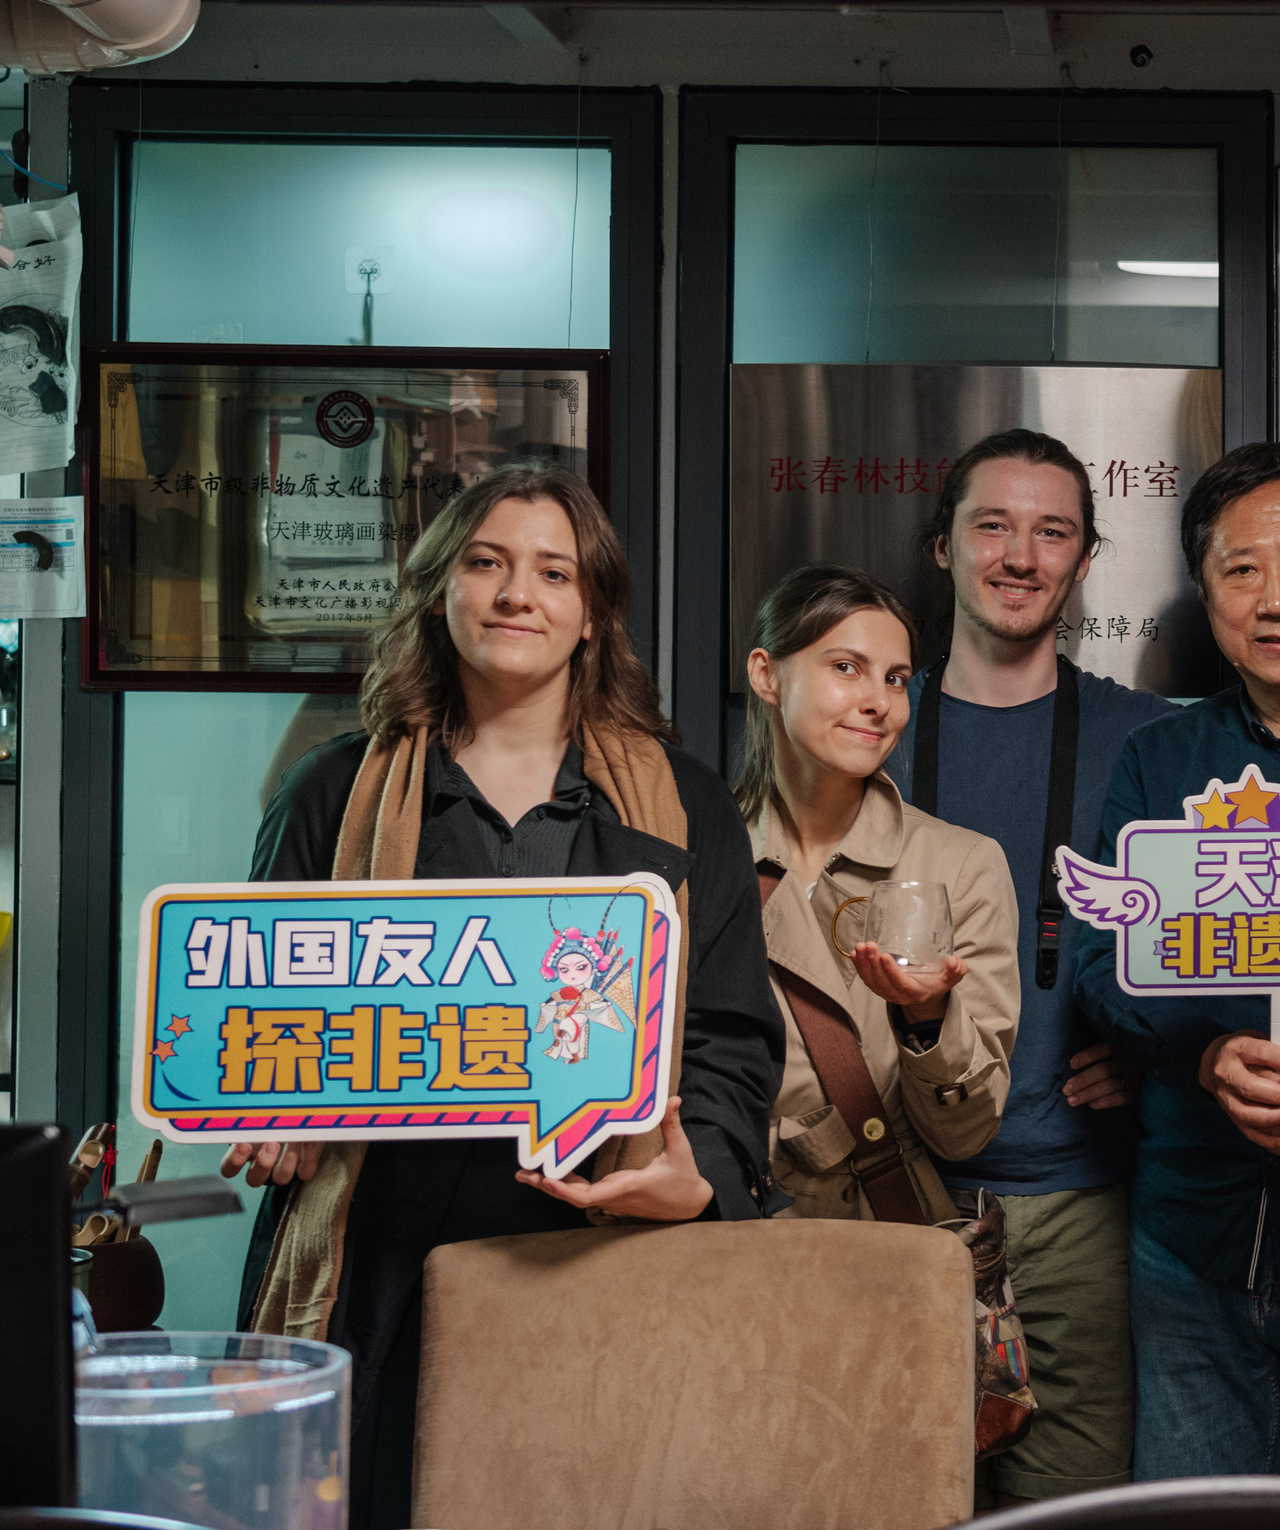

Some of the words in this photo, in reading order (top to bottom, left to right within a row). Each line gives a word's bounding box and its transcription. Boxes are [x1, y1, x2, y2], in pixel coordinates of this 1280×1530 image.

[150, 470, 480, 500] 天津市级非物质文化遗产代表
[770, 455, 1181, 499] 张春林技作室
[316, 612, 373, 624] 2017年5月
[185, 916, 516, 988] 外国友人
[219, 1004, 532, 1094] 探非遗
